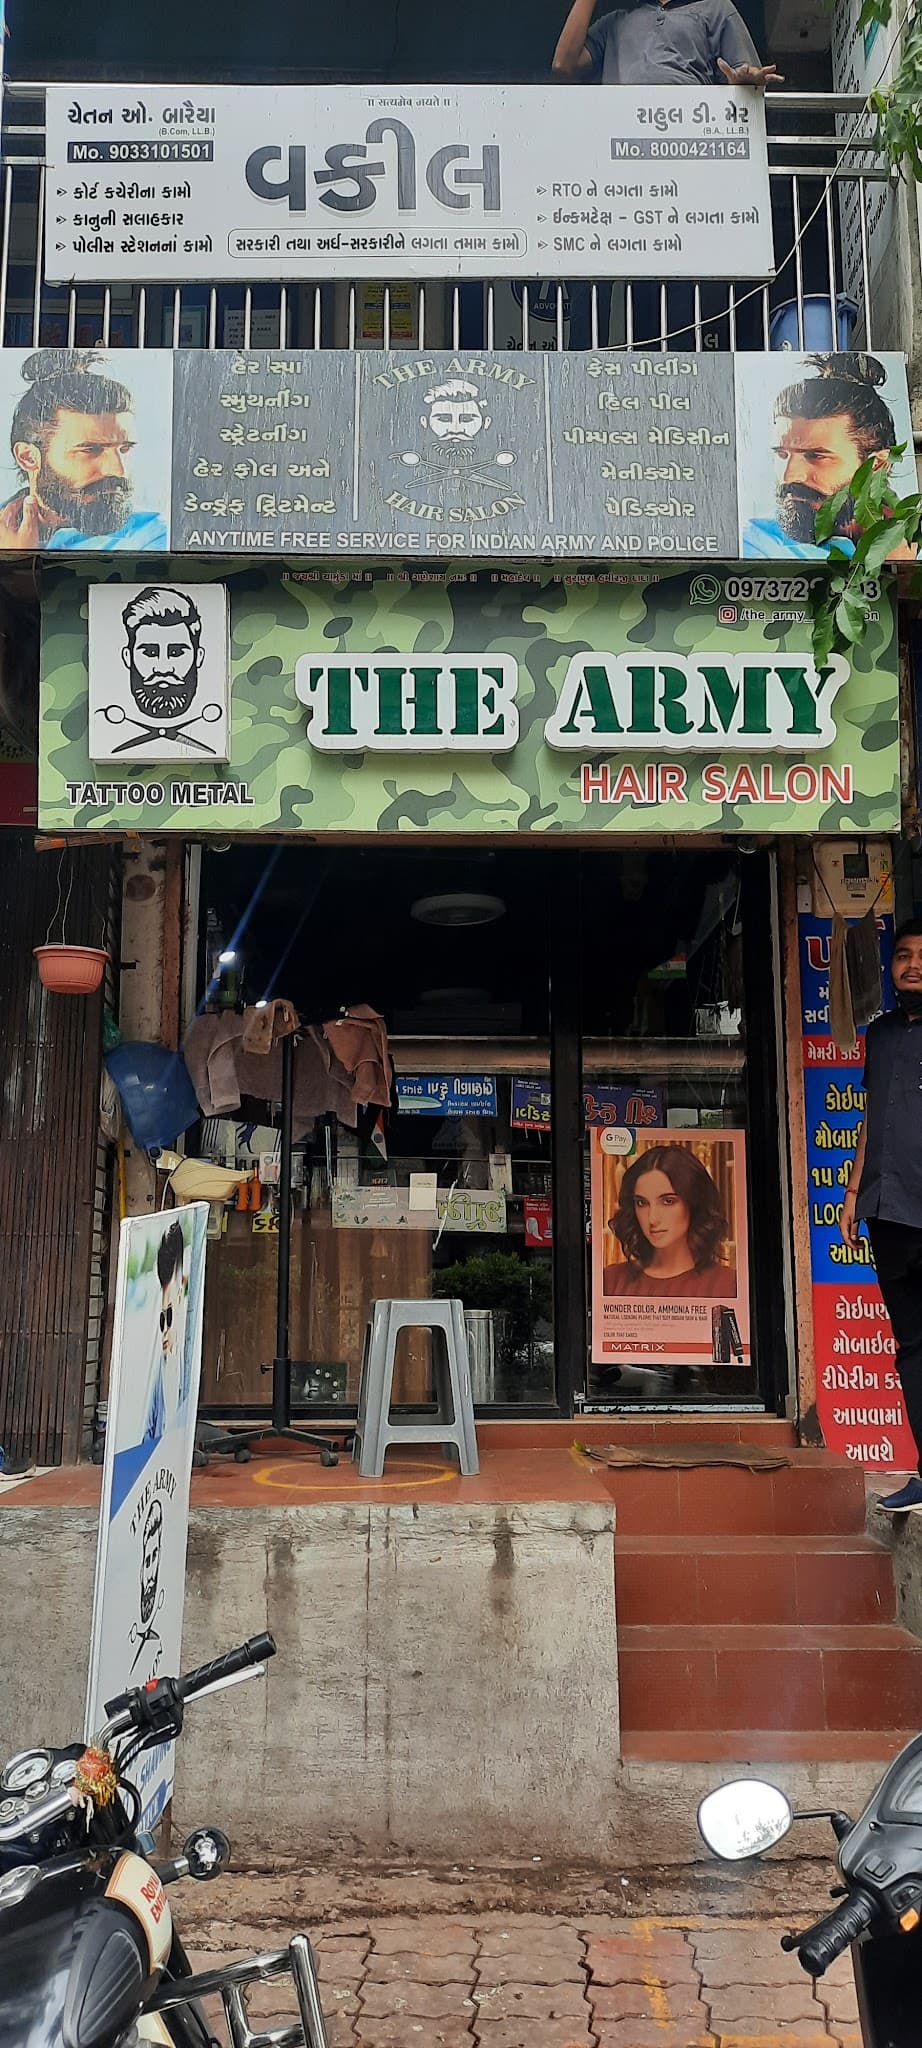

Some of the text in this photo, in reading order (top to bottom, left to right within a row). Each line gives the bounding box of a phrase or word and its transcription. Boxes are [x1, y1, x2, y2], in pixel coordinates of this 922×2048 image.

[68, 99, 216, 125] ચેતન ઓ. બારૈયા
[637, 101, 750, 132] રાહુલ ડી. મેર
[159, 126, 190, 137] (B.Com,
[73, 142, 211, 161] Mo. 9033101501
[616, 140, 747, 158] Mo. 8000421164
[245, 117, 501, 214] વકીલ
[73, 181, 191, 200] કોર્ટ કચેરીના કામો
[552, 179, 679, 198] RTO ને લગતા કામો
[73, 209, 184, 231] કાનુની સલાહકાર
[552, 208, 613, 225] ઈન્કમટેક્ષ
[633, 209, 664, 225] GST
[668, 207, 680, 225] ને
[685, 211, 726, 226] લગતા
[730, 207, 760, 225] કામો
[73, 233, 213, 254] પોલીસ સ્ટેશનનાં કામો
[235, 233, 280, 252] સરકારી
[286, 235, 311, 252] તથા
[411, 236, 448, 251] લગતા
[454, 235, 487, 251] તમામ
[492, 231, 520, 251] કામો
[553, 233, 682, 252] SMC ને લગતા કામો
[230, 355, 302, 375] હેર સ્પા
[372, 357, 536, 392] THE ARMY
[586, 358, 622, 378] ફેસ
[598, 391, 691, 411] હિલ પીલ
[648, 426, 730, 446] મેડિસીન
[192, 457, 331, 480] હેર ફોલ અને
[600, 461, 696, 481] મેનીક્યોર
[383, 490, 527, 523] HAIR SALON
[605, 496, 696, 518] પેડિક્યોર
[187, 530, 719, 553] ANYTIME FREE SERVICE FOR INDIAN ARMY AND POLICE
[308, 665, 836, 736] THE ARMY
[65, 781, 255, 807] TATTOO METAL
[581, 763, 854, 804] HAIR SALON
[807, 1040, 837, 1061] મેમરી
[605, 1133, 627, 1144] G Pay
[603, 1303, 632, 1314] WONDER
[657, 1305, 691, 1315] AMMONIA
[691, 1305, 708, 1315] FREE
[610, 1343, 666, 1352] MATRIX
[832, 1329, 897, 1356] મોબાઈલ
[832, 1400, 903, 1426] આપવામાં
[844, 1441, 895, 1462] આવશે
[128, 1468, 178, 1538] THE ARMY
